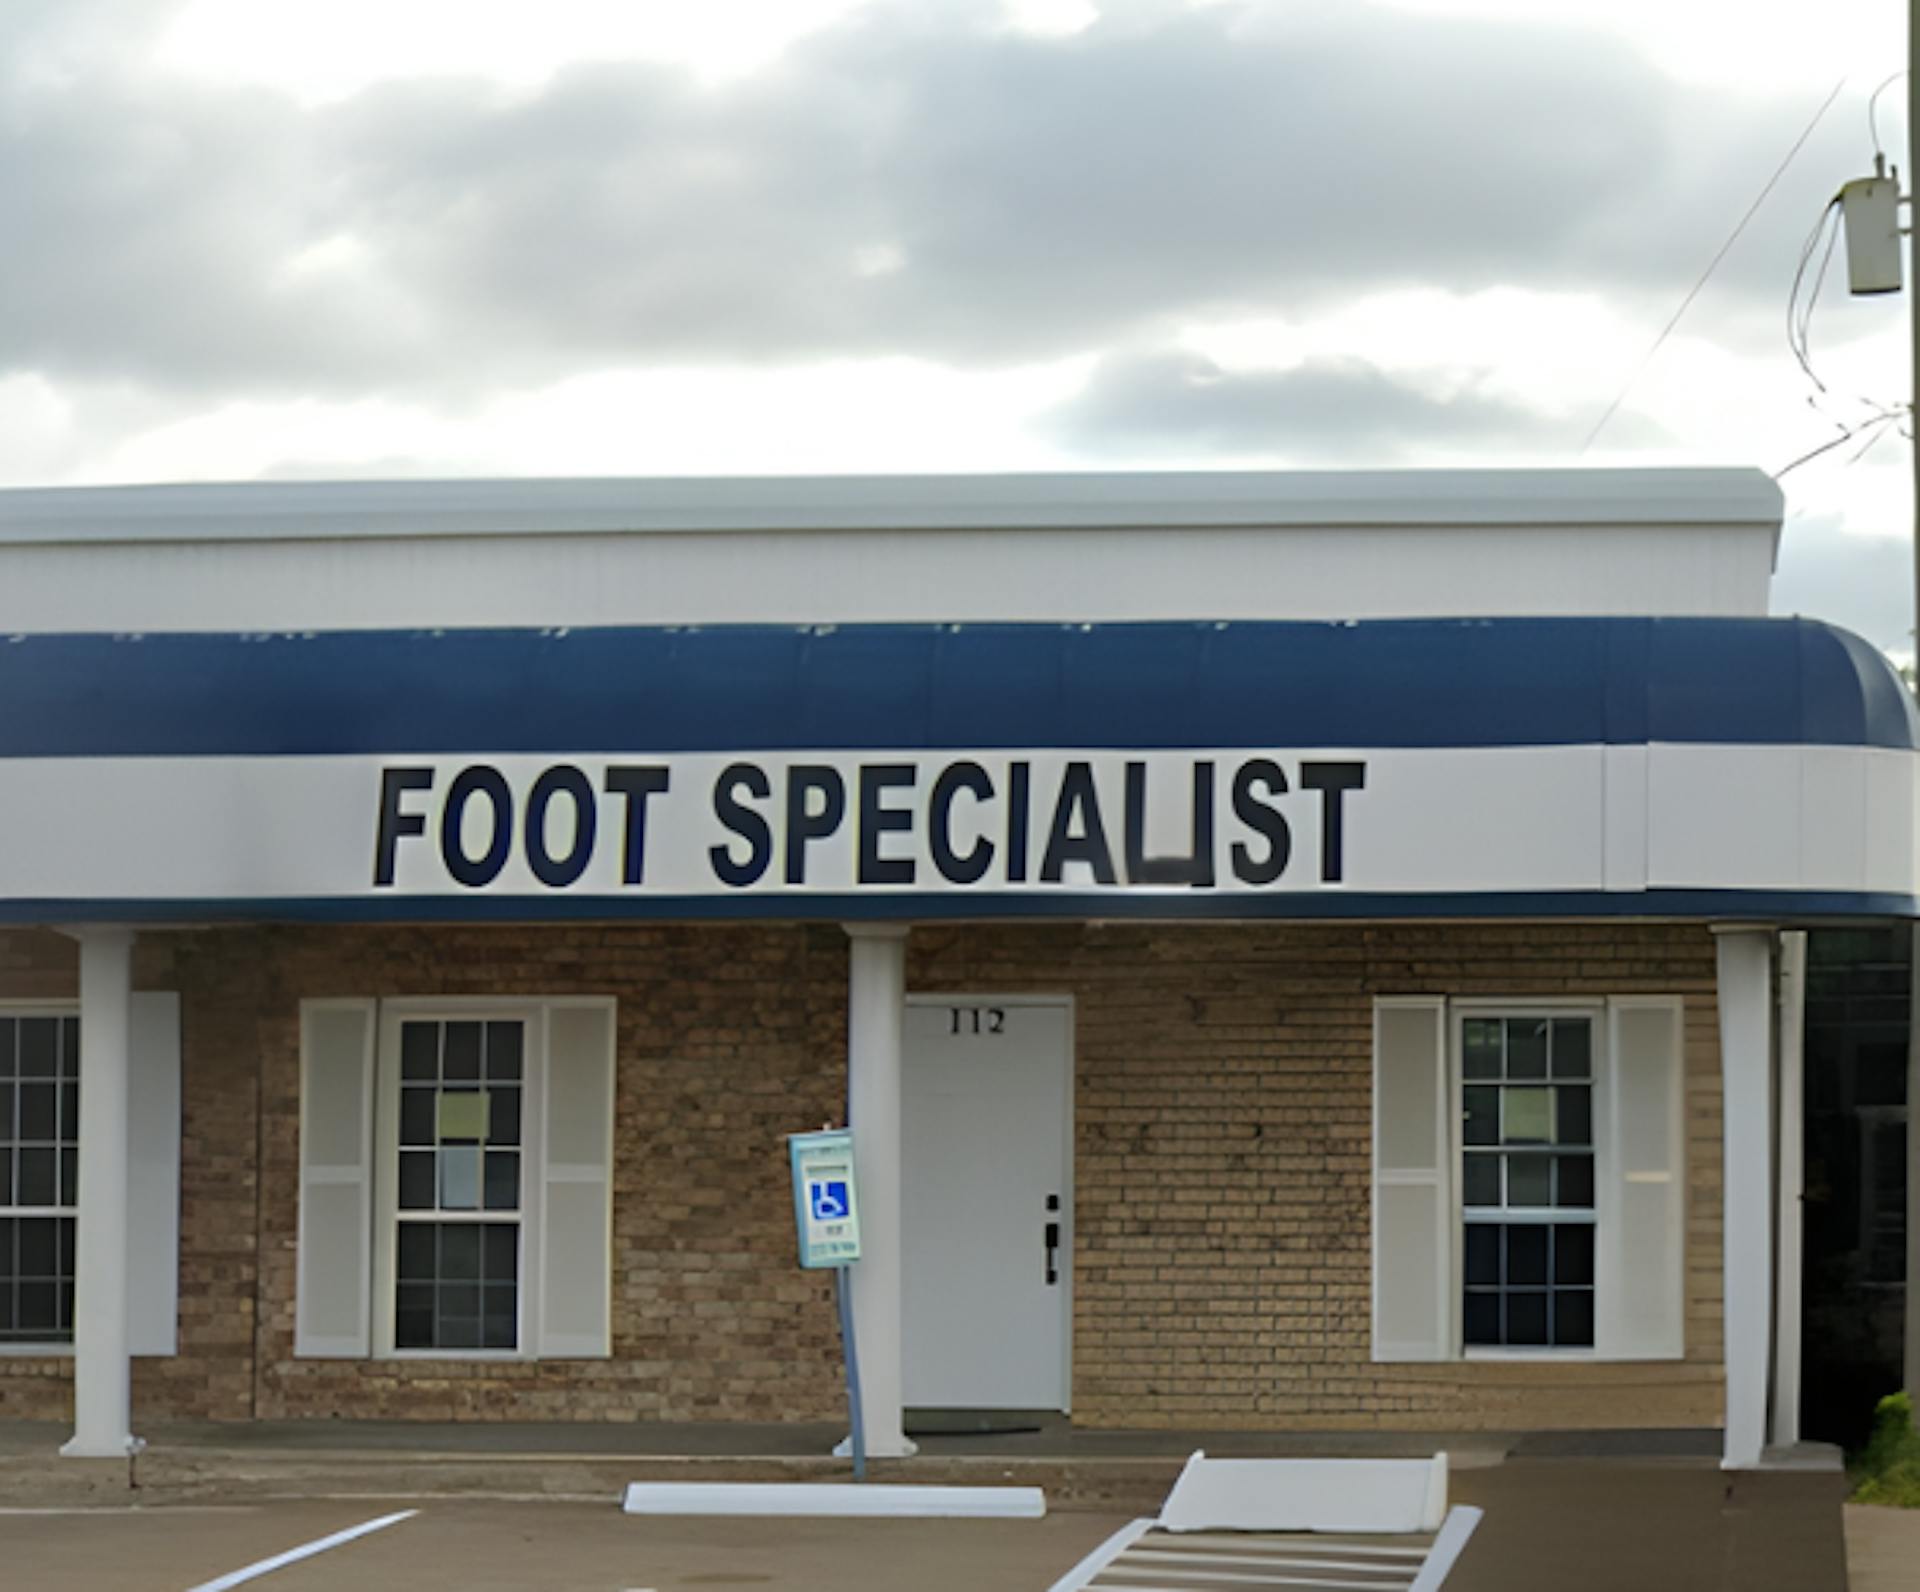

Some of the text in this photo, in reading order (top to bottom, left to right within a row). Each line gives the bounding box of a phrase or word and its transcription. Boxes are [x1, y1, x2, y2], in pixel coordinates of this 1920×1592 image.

[372, 758, 1366, 888] FOOT SPECIALIST
[951, 1007, 1005, 1034] 112
